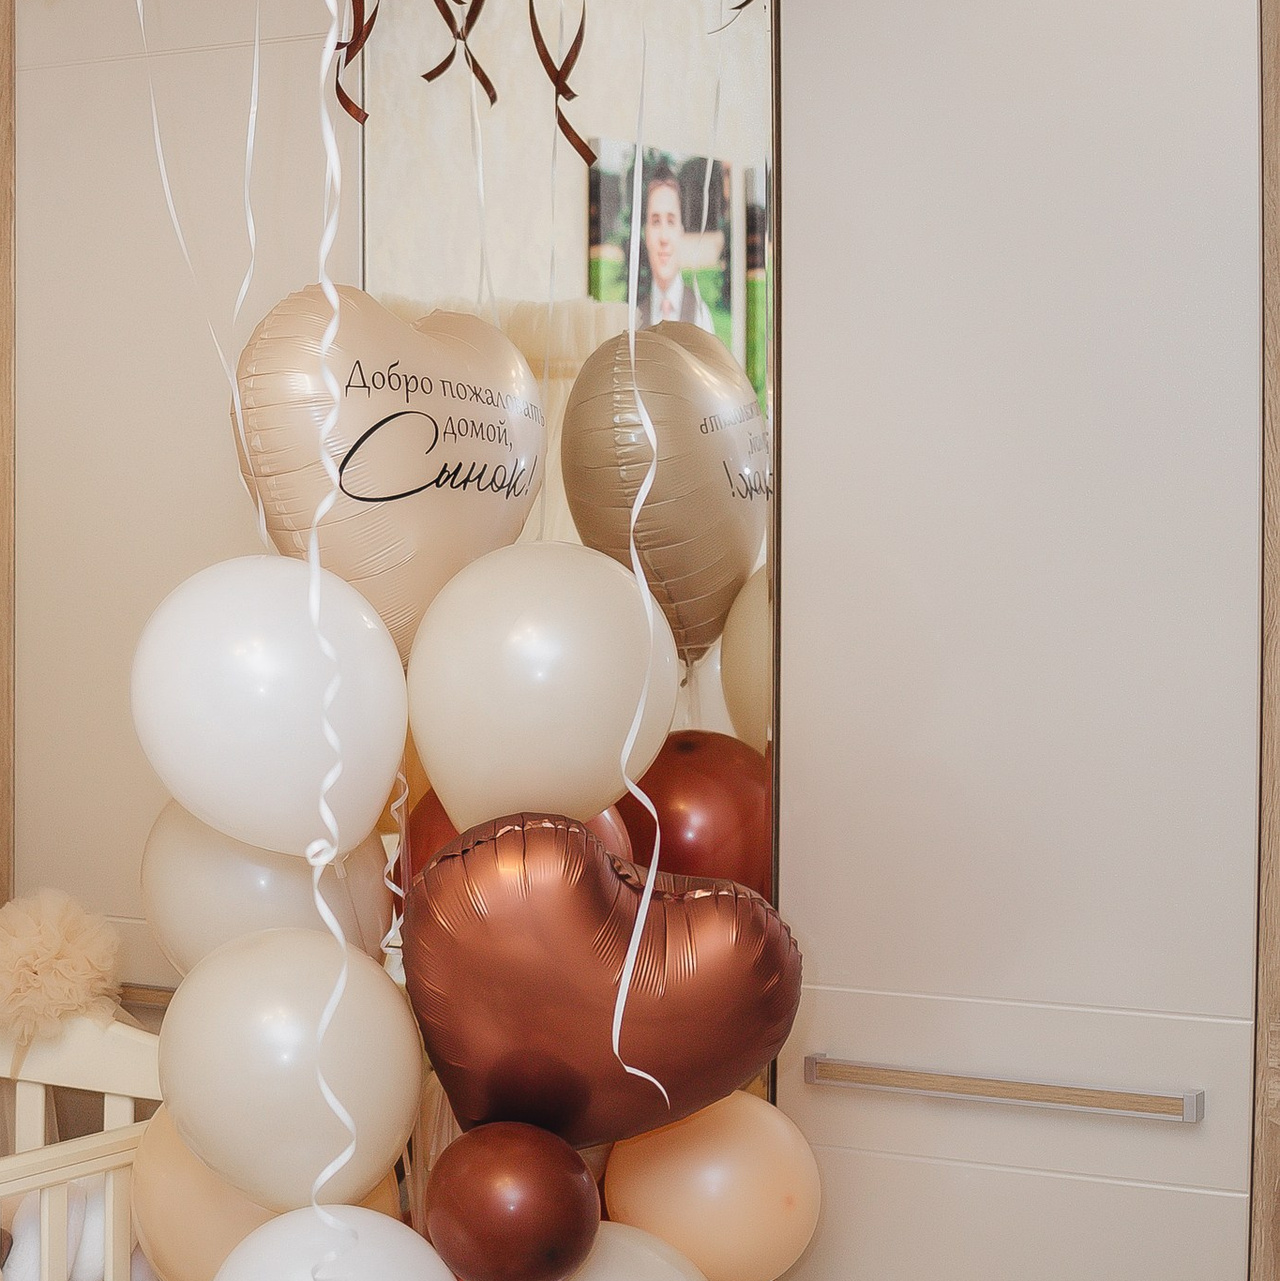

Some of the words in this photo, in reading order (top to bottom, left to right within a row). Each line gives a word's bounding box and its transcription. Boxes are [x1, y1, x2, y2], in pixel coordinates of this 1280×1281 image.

[345, 360, 433, 403] Добро
[444, 416, 513, 452] домой,
[339, 411, 537, 502] Сынок!
